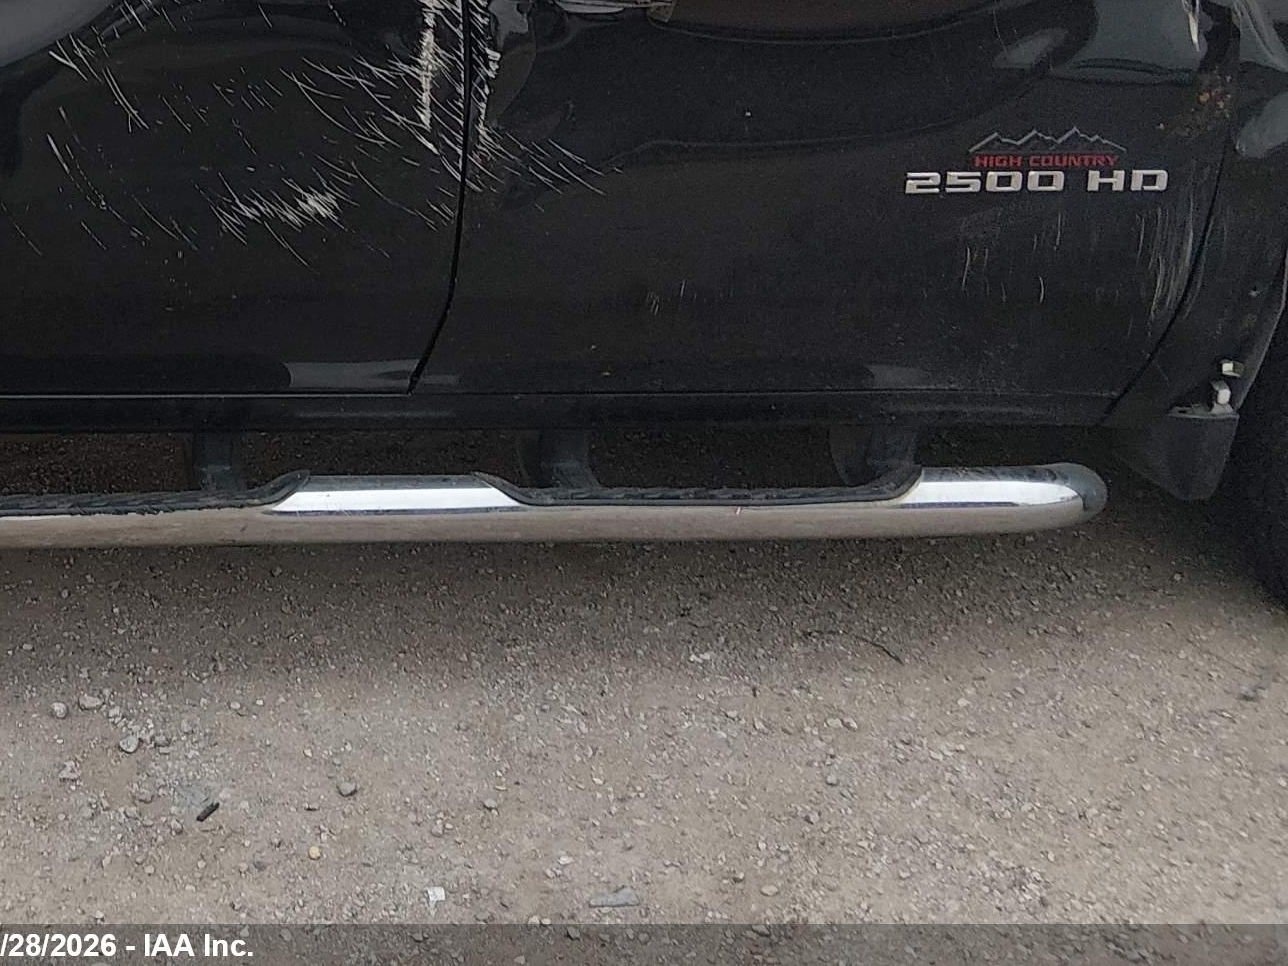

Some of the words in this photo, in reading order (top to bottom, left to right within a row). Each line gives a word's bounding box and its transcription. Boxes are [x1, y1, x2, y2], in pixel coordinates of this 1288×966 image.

[974, 154, 1022, 167] HIGH
[1029, 154, 1119, 167] COUNTRY
[905, 170, 1065, 194] 2500
[1087, 169, 1169, 192] HD
